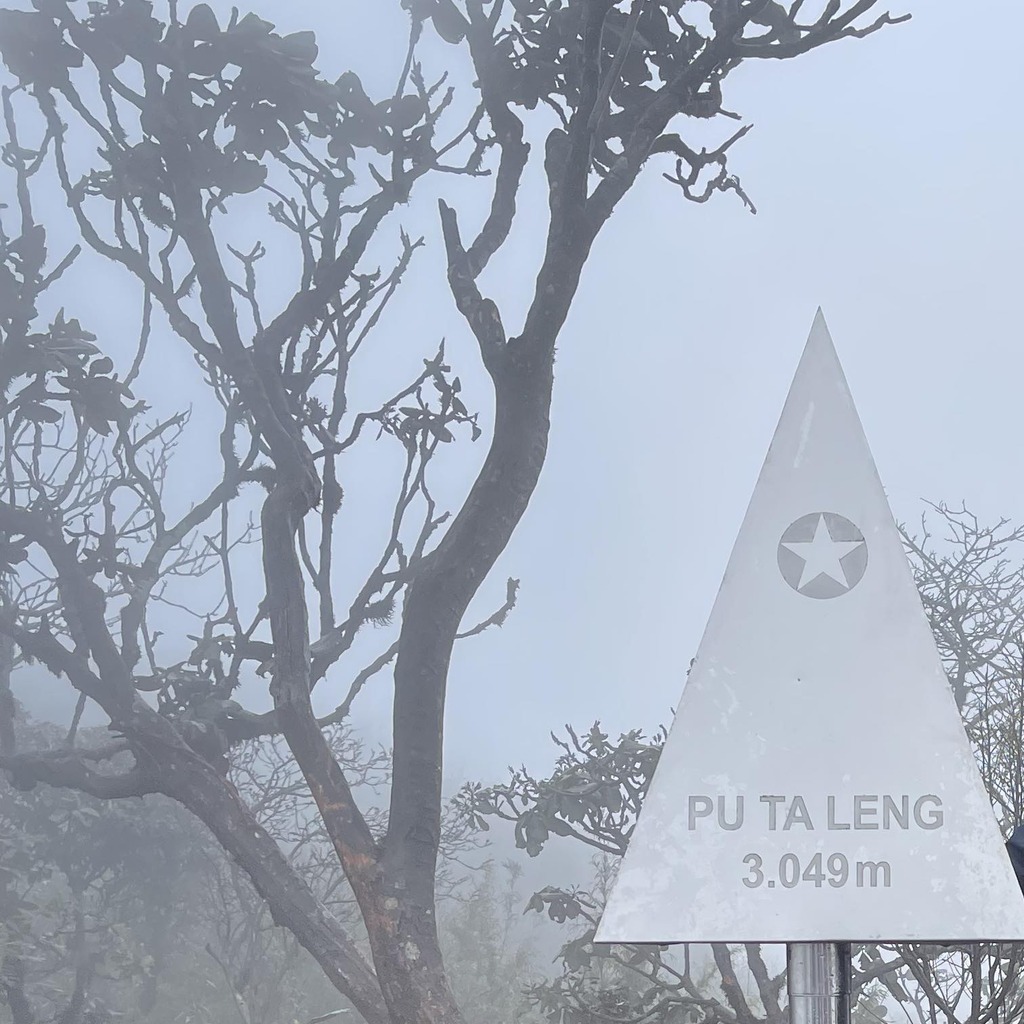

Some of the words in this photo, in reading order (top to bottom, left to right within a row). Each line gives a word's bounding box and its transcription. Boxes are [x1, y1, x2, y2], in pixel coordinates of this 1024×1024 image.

[688, 795, 744, 831] PU
[759, 795, 814, 831] TA
[827, 794, 944, 831] LENG
[742, 852, 892, 889] 3.049m
